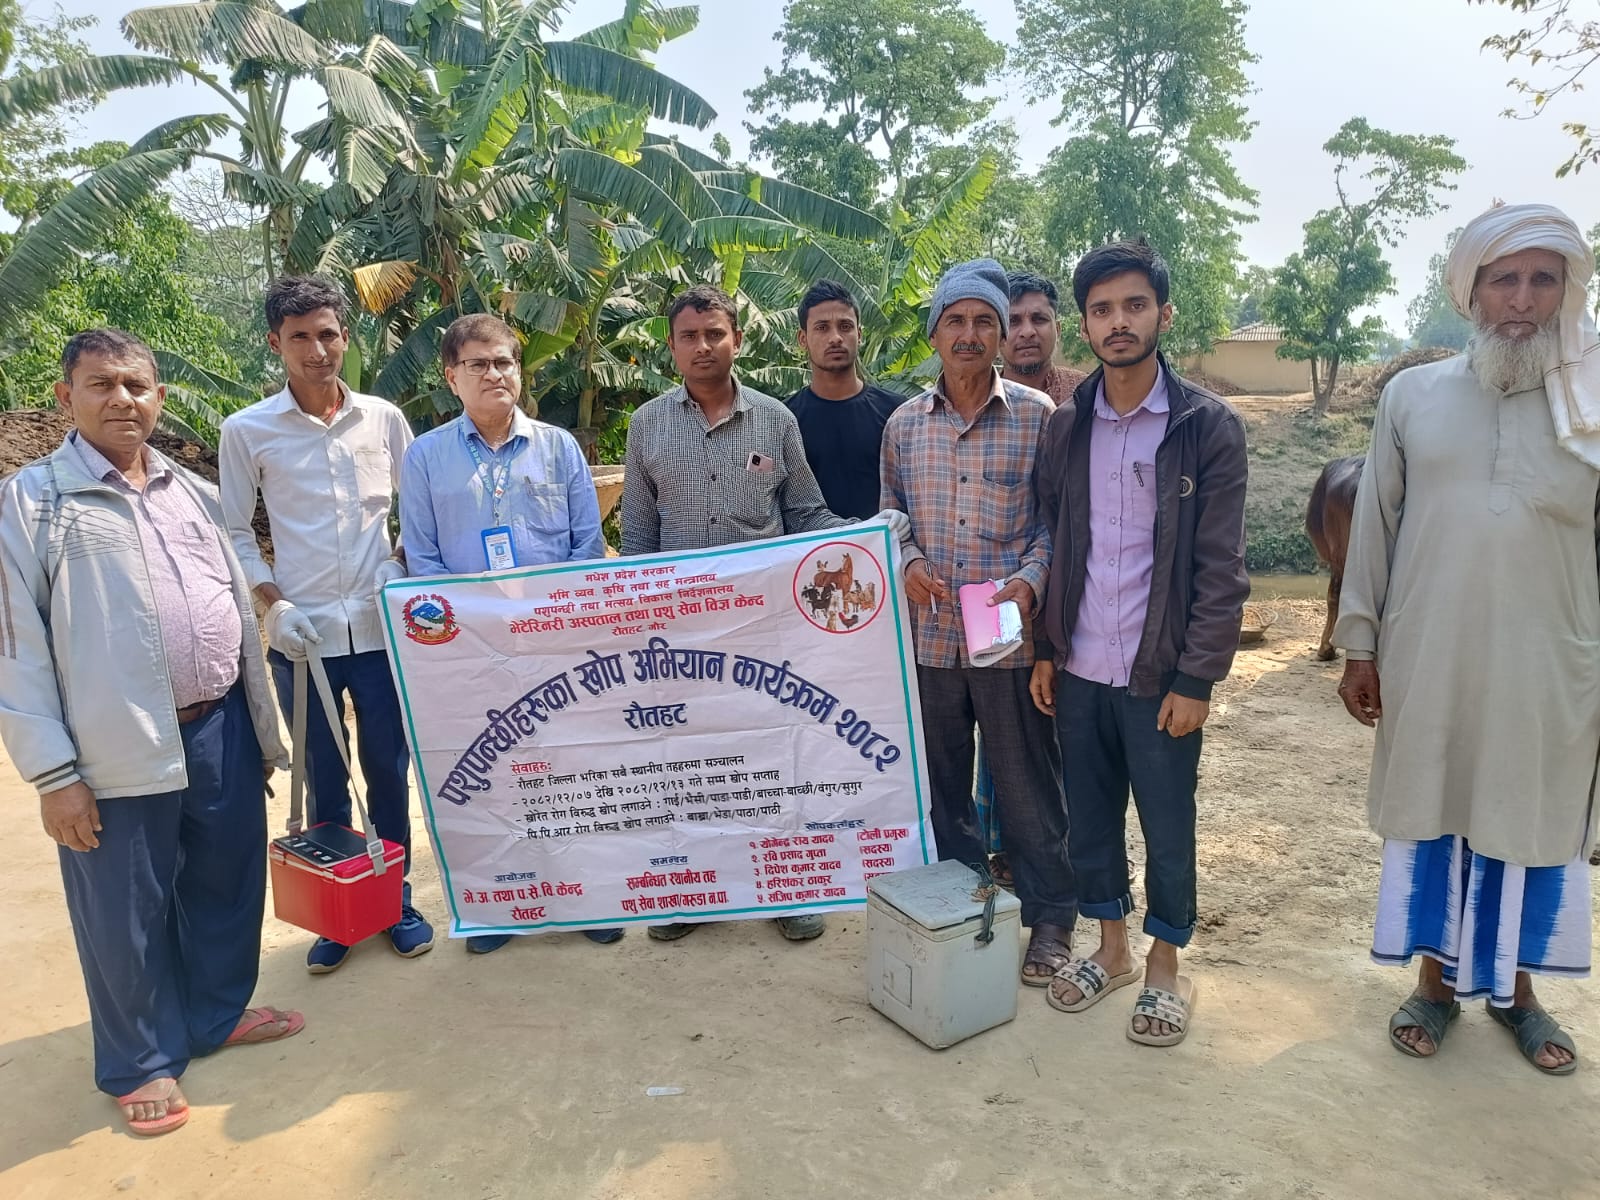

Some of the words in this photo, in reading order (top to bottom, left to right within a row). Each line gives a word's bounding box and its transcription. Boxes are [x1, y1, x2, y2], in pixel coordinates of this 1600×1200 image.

[585, 572, 610, 582] मधेश
[614, 569, 637, 580] प्रदेश
[641, 565, 676, 577] सरकार
[548, 589, 570, 603] भूमि
[602, 583, 626, 598] कृषि
[655, 579, 670, 589] सह
[674, 573, 717, 586] मन्त्रालय
[638, 592, 673, 605] विकास
[509, 616, 565, 634] भेटेरिनरी
[567, 612, 622, 629] अस्पताल
[624, 608, 650, 622] तथा
[653, 605, 676, 622] पशु
[678, 601, 702, 616] सेवा
[705, 597, 731, 612] विज्ञ
[573, 649, 627, 696] खोप
[628, 636, 726, 683] अभियान
[733, 654, 839, 724] कार्यक्रम
[835, 708, 901, 772] २०८२
[623, 701, 687, 729] रौतहट
[517, 776, 545, 790] रौतहट
[547, 774, 577, 786] जिल्ला
[580, 769, 608, 783] भरिका
[611, 764, 627, 778] सबै
[630, 762, 662, 776] स्थानीय
[704, 755, 744, 768] सञ्चालन
[521, 789, 592, 807] २०८२/१२/०७
[595, 785, 614, 799] देखि
[618, 779, 684, 795] २०८२/१२/१३
[688, 773, 702, 787] गते
[705, 775, 726, 786] सम्म
[729, 770, 749, 784] खोप
[752, 770, 780, 782] सप्ताह
[524, 808, 549, 823] खोरेत
[551, 807, 567, 820] रोग
[598, 802, 617, 816] खोप
[620, 797, 652, 812] लगाउने
[574, 821, 591, 835] रोग
[622, 816, 641, 830] खोप
[644, 810, 675, 826] लगाउने
[759, 837, 791, 849] योगेन्द्र
[811, 834, 835, 844] यादव
[762, 850, 778, 862] रवि
[779, 850, 804, 861] प्रसाद
[805, 848, 827, 860] गुप्ता
[859, 843, 893, 855] (सदस्य)
[494, 871, 537, 882] आयोजक
[764, 863, 788, 875] दिपेश
[791, 862, 816, 875] कुमार
[818, 860, 842, 871] यादव
[862, 857, 895, 868] (सदस्य)
[626, 871, 667, 891] सम्बन्धित
[668, 868, 701, 886] स्थानीय
[702, 870, 717, 884] तह
[807, 874, 832, 886] ठाकुर
[492, 889, 515, 903] तथा
[555, 881, 584, 897] केन्द्र
[795, 889, 820, 902] कुमार
[823, 887, 846, 897] यादव
[621, 899, 639, 914] पशु
[638, 894, 656, 911] सेवा
